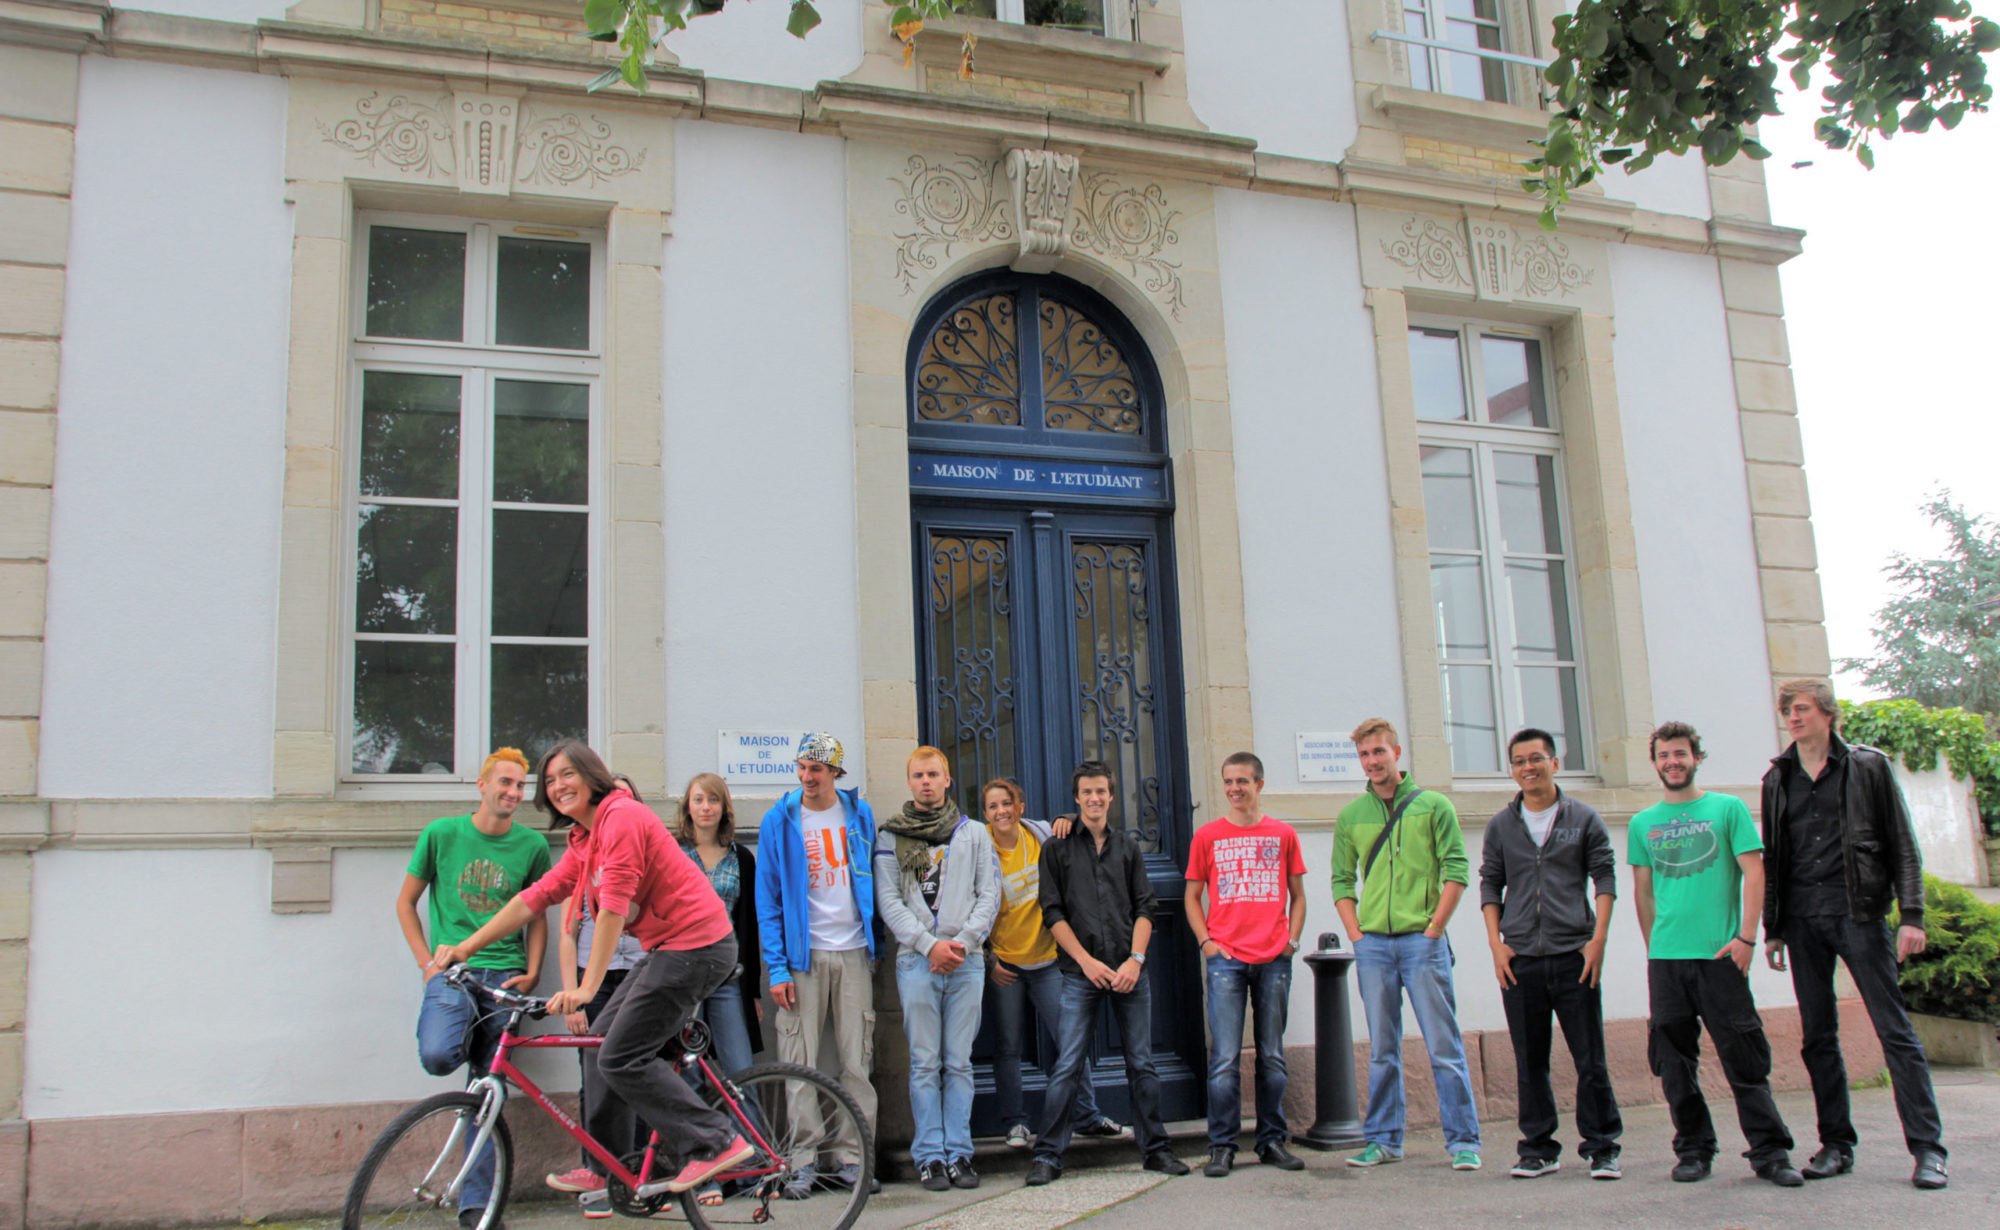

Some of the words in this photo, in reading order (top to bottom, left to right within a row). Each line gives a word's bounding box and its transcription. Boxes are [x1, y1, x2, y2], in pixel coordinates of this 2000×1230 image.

[933, 463, 998, 480] MAISON
[1013, 468, 1036, 482] DE
[1050, 471, 1143, 489] L'ETUDIANT
[740, 735, 789, 747] MAISON
[758, 750, 772, 759] DE
[1663, 821, 1714, 841] FUNNY
[1213, 836, 1281, 850] PRINCETON
[1214, 847, 1257, 863] HOME
[1216, 860, 1238, 873] THE
[1241, 859, 1281, 870] BRAVE
[1217, 869, 1280, 887] COLLEGE
